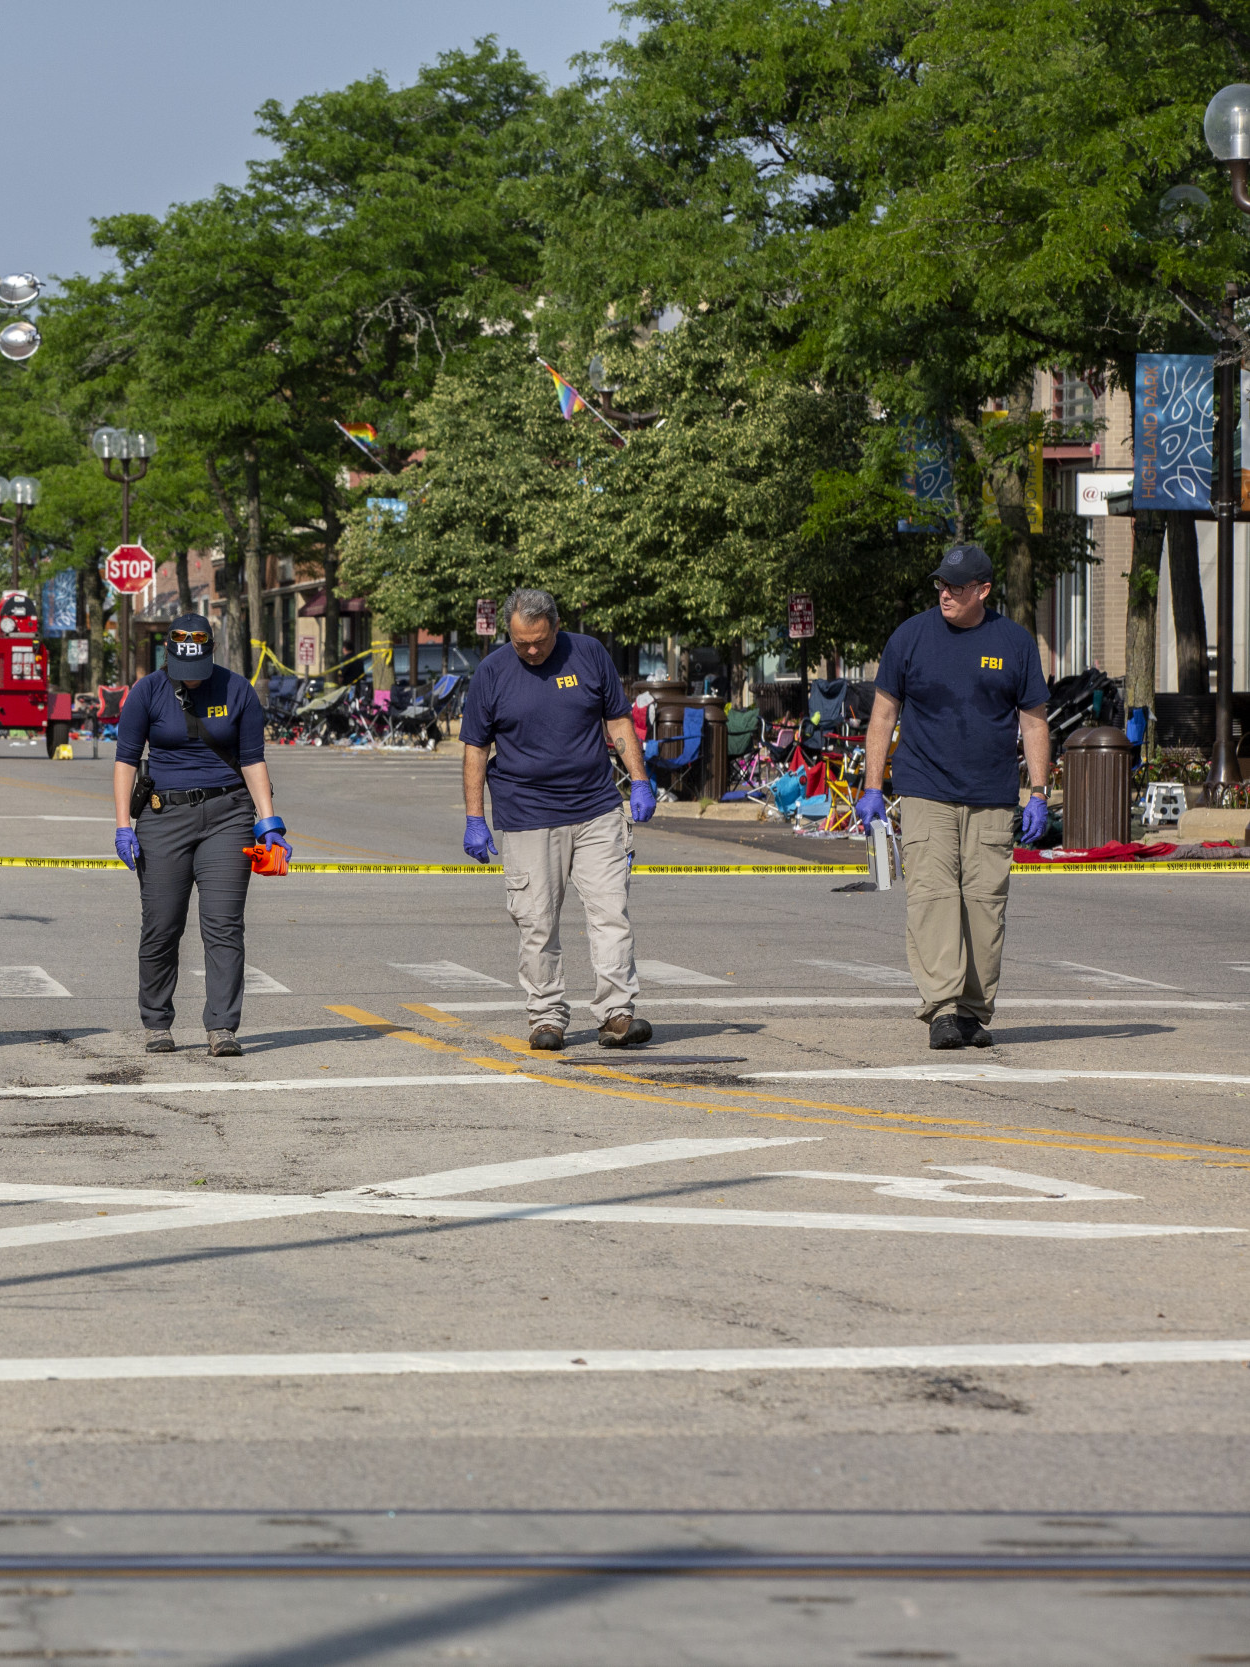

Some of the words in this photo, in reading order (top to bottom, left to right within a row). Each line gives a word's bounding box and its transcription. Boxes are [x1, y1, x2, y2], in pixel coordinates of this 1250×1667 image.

[1144, 366, 1158, 408] PARK
[1142, 413, 1158, 499] HIGHLAND
[110, 560, 151, 579] STOP
[177, 643, 203, 657] FBI
[981, 656, 1003, 670] FBI
[556, 674, 579, 689] FBI
[207, 705, 228, 718] FBI
[251, 848, 264, 863] 26
